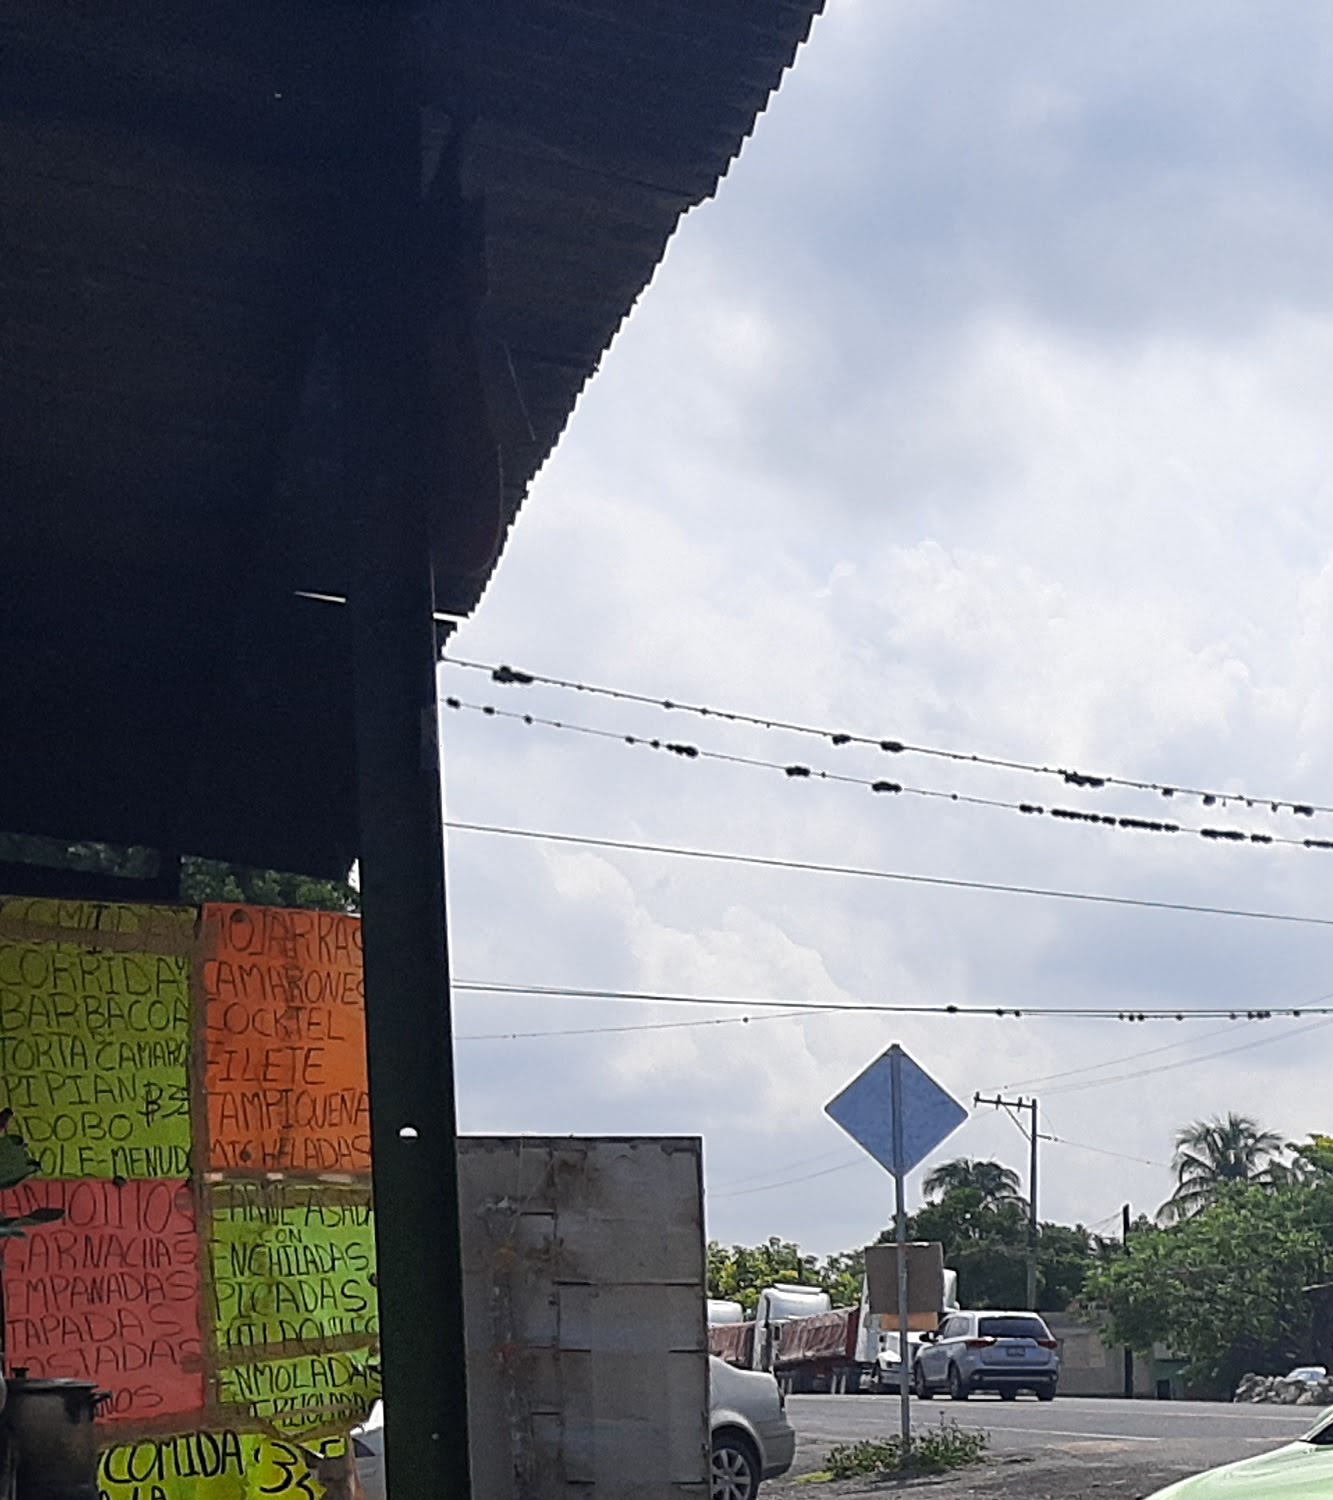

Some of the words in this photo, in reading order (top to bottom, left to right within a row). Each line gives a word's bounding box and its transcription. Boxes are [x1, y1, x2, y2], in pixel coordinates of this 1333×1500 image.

[0, 943, 184, 997] CORRIDA
[0, 989, 190, 1034] BARBACOA
[0, 1031, 88, 1071] TORTA
[2, 1070, 138, 1107] PIPIAN
[38, 1144, 190, 1178] OLE-MENUD
[258, 1228, 303, 1244] CON
[208, 1240, 370, 1278] ENCHILADAS
[5, 1269, 197, 1316] EMPANADAS
[212, 1276, 368, 1321] PICADAS
[7, 1302, 184, 1354] TAPADAS
[103, 1430, 244, 1484] COMIDA
